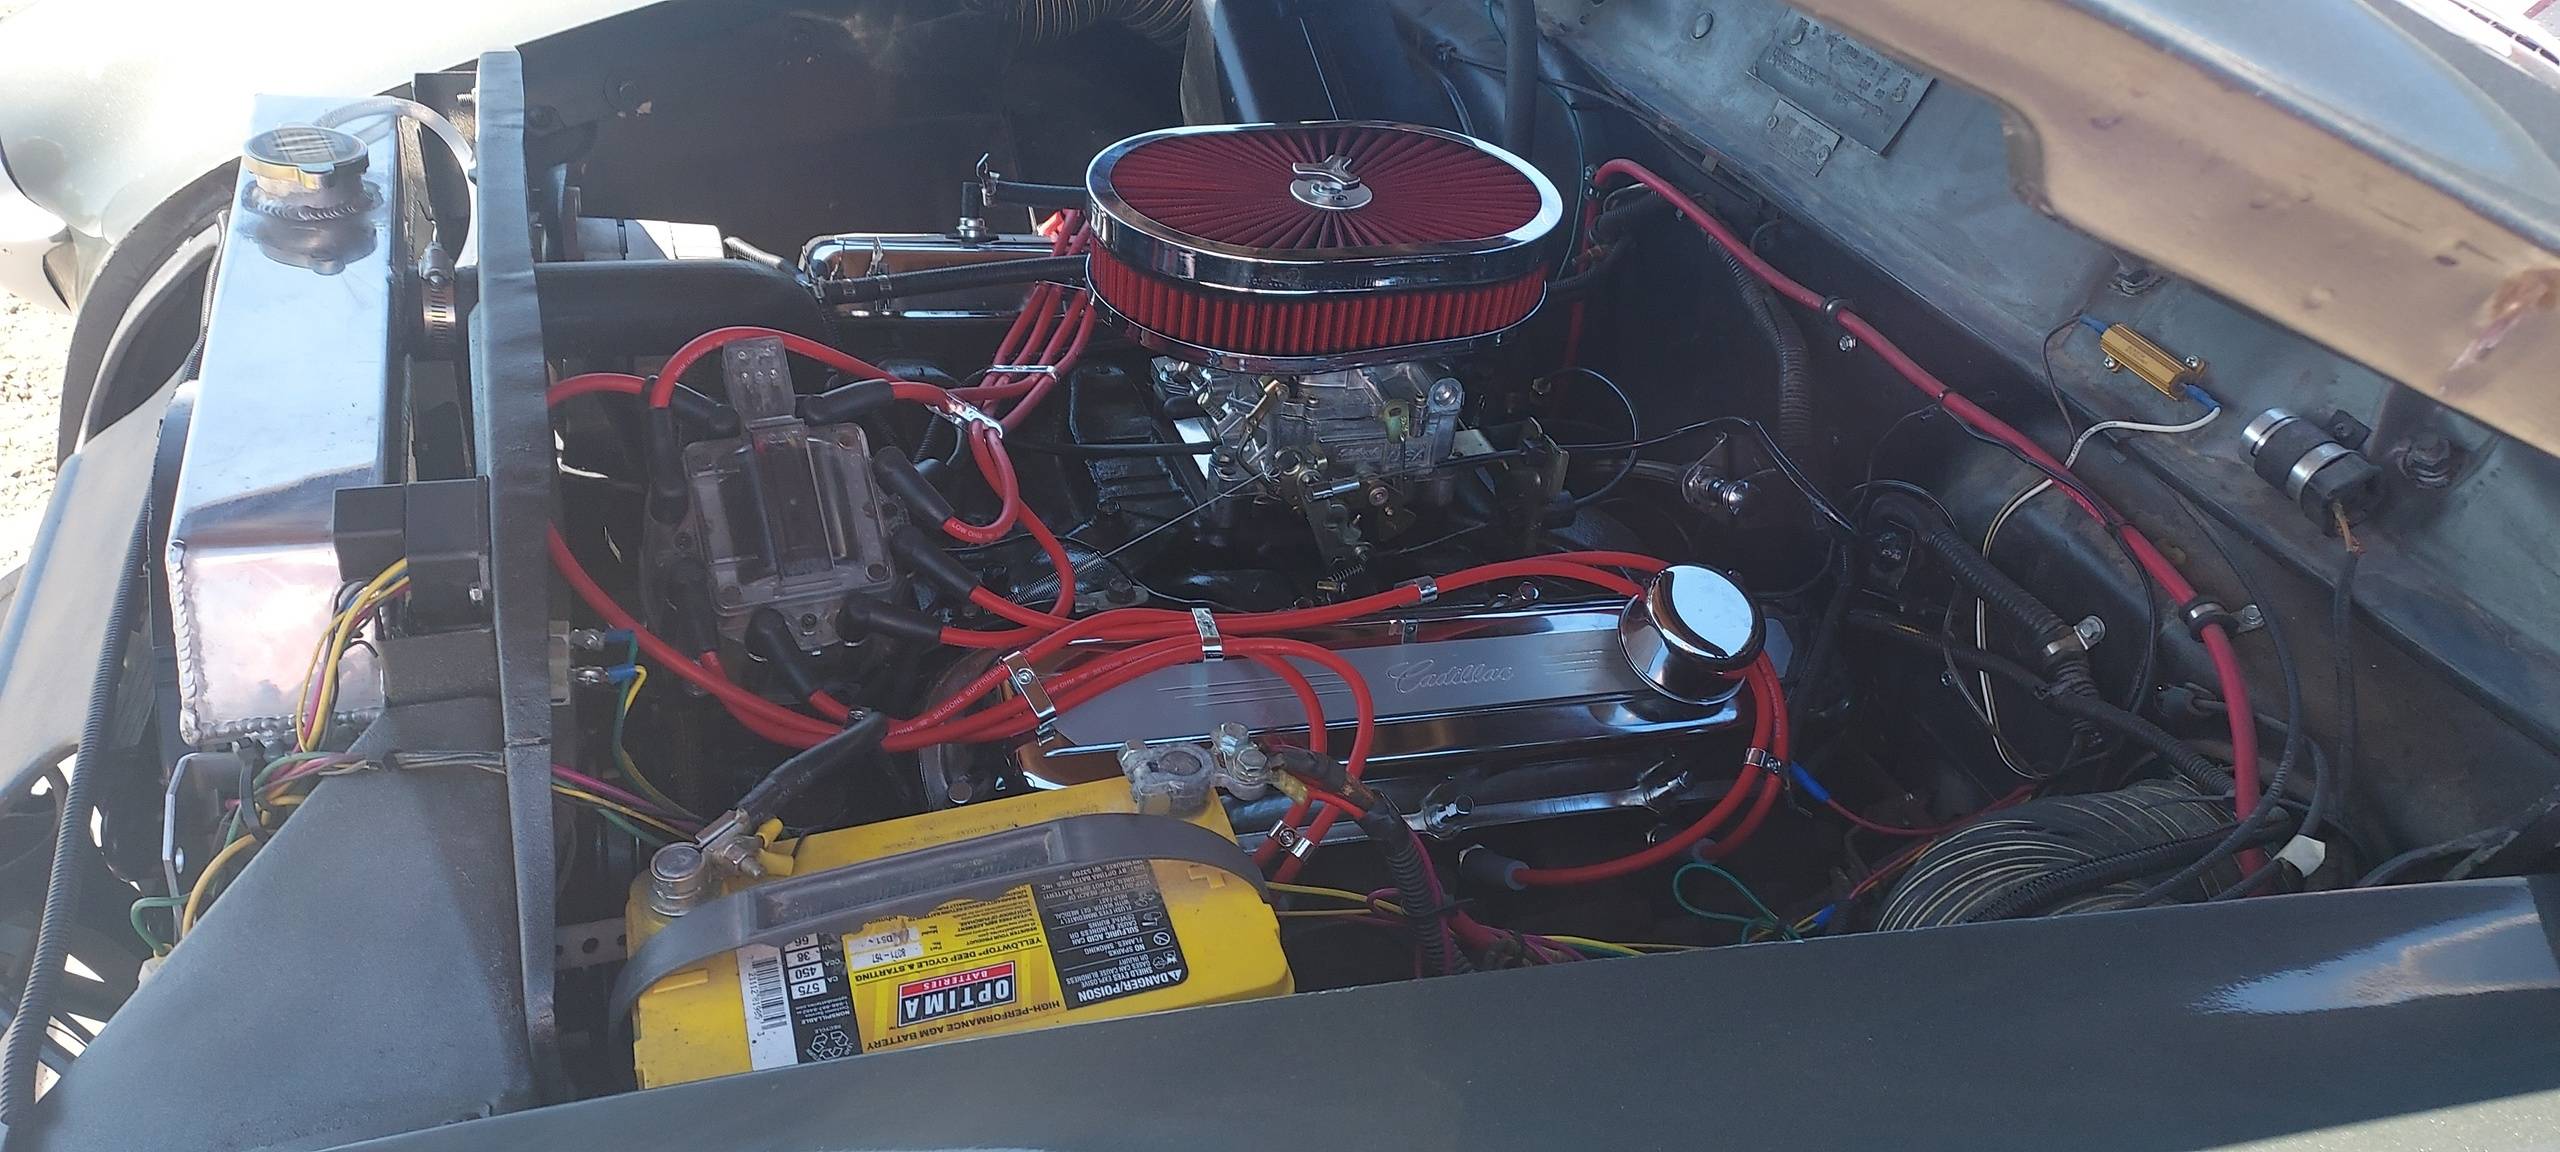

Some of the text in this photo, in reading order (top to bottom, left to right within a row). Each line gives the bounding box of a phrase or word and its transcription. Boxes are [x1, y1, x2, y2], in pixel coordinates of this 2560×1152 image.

[1384, 658, 1514, 695] Cadillac
[932, 695, 964, 721] SILICONE
[965, 662, 1007, 697] SUPPRESSIO
[1090, 869, 1116, 880] OPTIMA
[1068, 919, 1137, 939] CAUSE BLINDNESS OR
[1087, 918, 1110, 928] BURNS
[1071, 925, 1139, 945] SULFURIC ACID CAN
[1083, 942, 1114, 954] SMOKING
[1133, 942, 1145, 951] NO
[796, 950, 810, 962] 38
[823, 957, 840, 966] CCA
[916, 956, 948, 968] CYCLE
[949, 950, 975, 961] DEEP
[794, 965, 817, 979] 450
[854, 965, 905, 982] STARTING
[1065, 959, 1150, 984] GASES CAN CAUSE BLINDNESS
[1080, 965, 1152, 988] SHIELD EYES EXPLOSIVE
[826, 975, 838, 983] CA
[921, 968, 988, 990] BATTERIES
[797, 982, 820, 996] 575
[1076, 971, 1169, 1002] DANGER/POISON
[903, 977, 1012, 1018] OPTIMA
[800, 1009, 850, 1024] NONSPILLABLE
[813, 1023, 841, 1033] RECYCLE
[866, 1000, 1060, 1050] HIGH-PERFORMANCE AGM BATTERY
